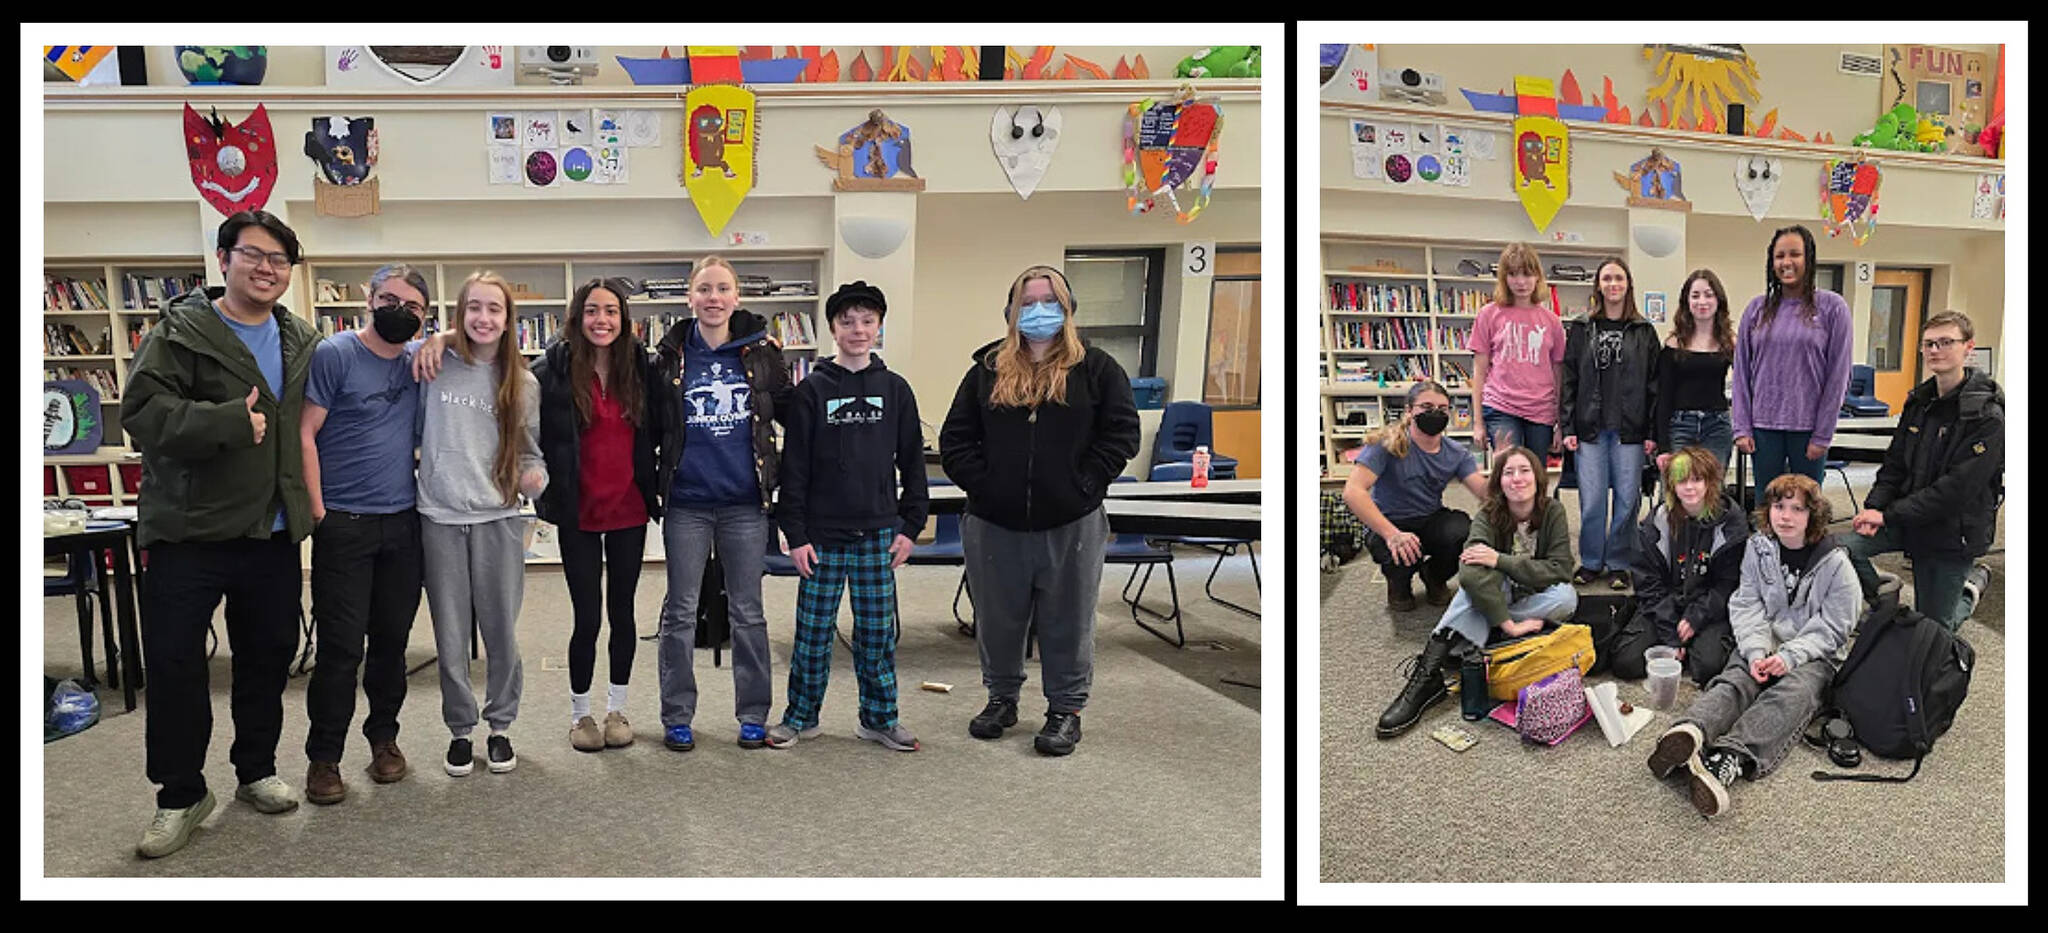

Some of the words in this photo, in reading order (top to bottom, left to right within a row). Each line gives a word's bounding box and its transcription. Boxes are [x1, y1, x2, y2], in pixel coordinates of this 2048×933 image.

[1909, 48, 1963, 75] FUN
[1189, 246, 1206, 273] 3
[1859, 263, 1869, 281] 3
[441, 391, 476, 407] black
